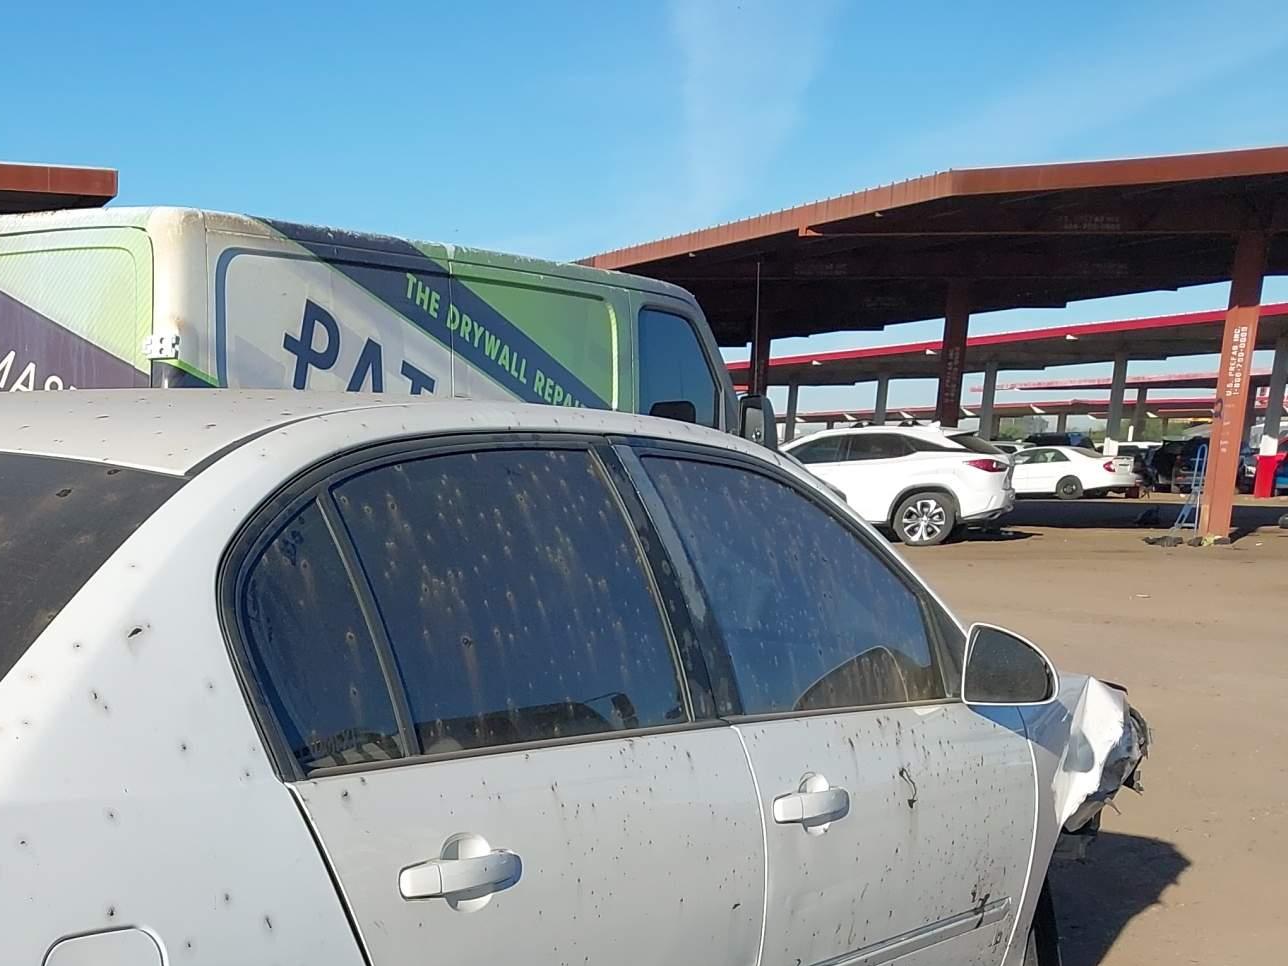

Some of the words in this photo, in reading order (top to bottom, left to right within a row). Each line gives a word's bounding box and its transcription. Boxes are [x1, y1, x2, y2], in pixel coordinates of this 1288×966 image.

[405, 273, 441, 319] THE
[446, 304, 527, 384] DRYWALL
[534, 369, 586, 408] REPA
